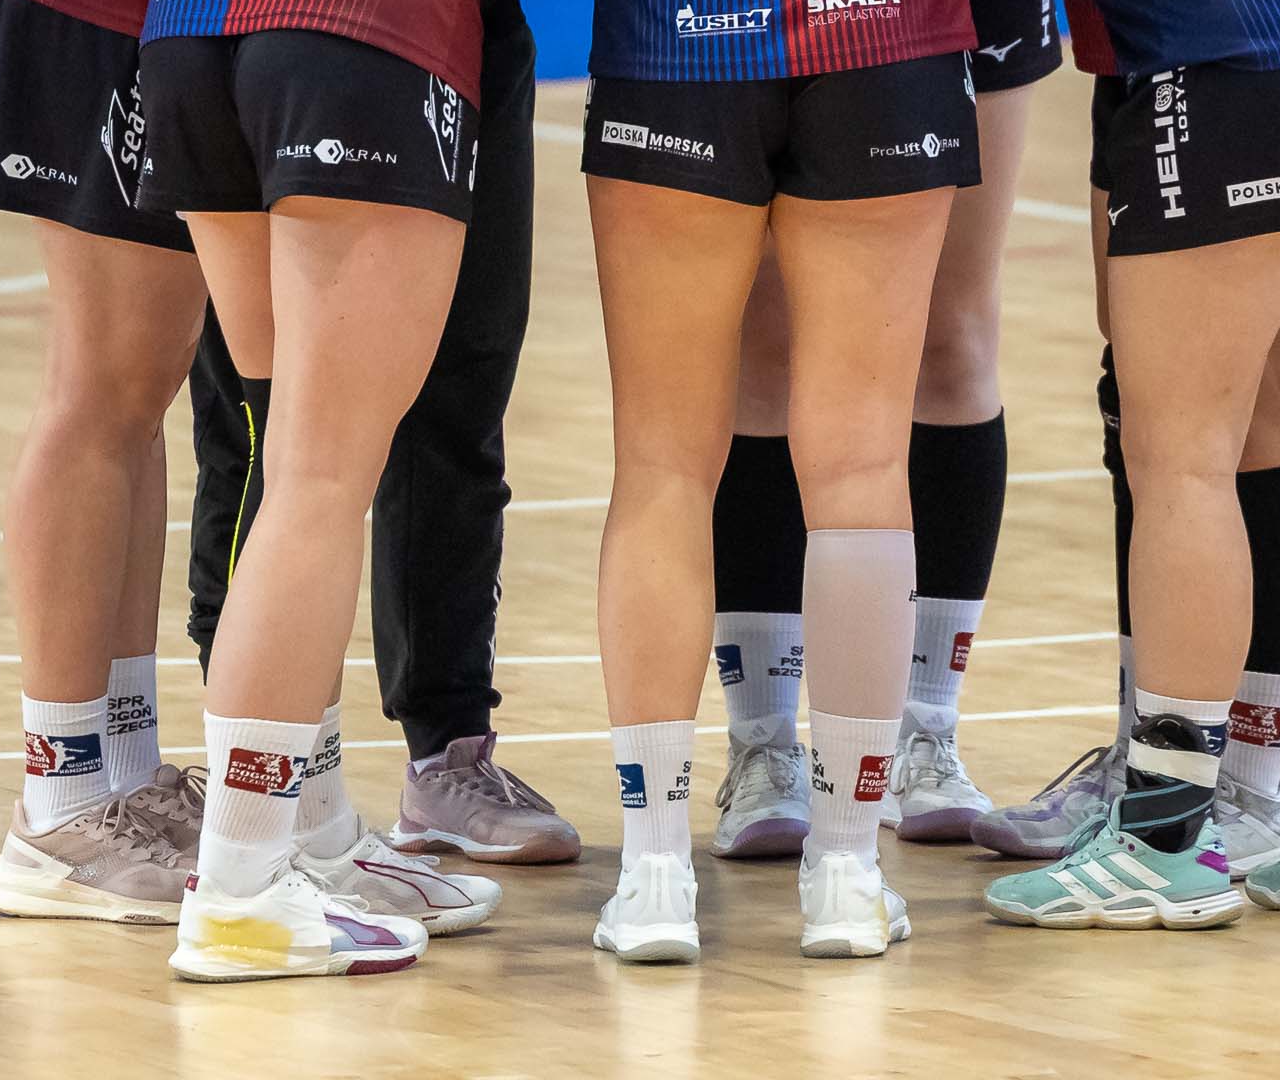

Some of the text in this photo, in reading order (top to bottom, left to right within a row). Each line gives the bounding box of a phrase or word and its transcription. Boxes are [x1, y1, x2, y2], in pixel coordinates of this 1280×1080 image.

[808, 11, 841, 27] SKLEP
[604, 125, 644, 144] POLSKA
[649, 133, 715, 158] MORSKA
[870, 142, 921, 157] ProLift
[345, 148, 398, 164] KRAN
[33, 165, 77, 186] KRAN
[862, 770, 880, 779] SPR
